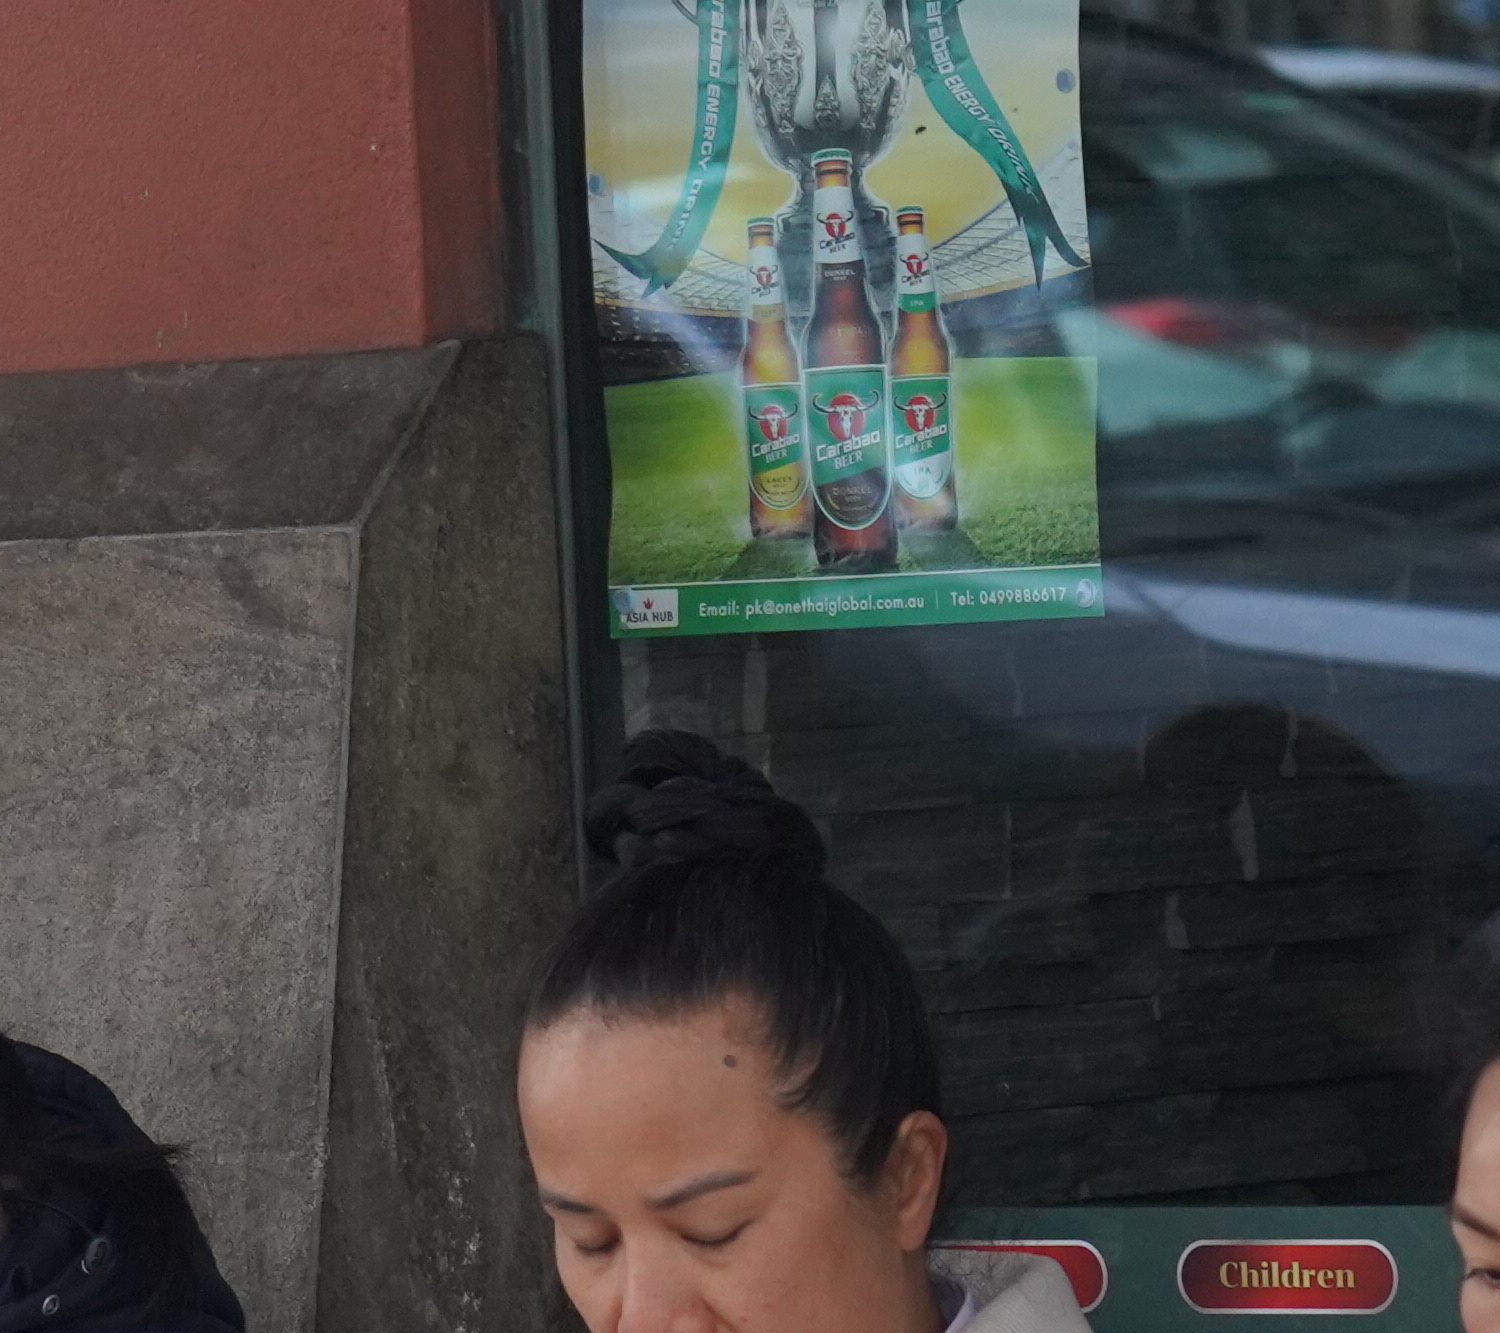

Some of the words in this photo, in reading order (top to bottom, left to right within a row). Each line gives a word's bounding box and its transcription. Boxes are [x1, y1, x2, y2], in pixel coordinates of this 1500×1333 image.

[944, 75, 995, 124] ENERGY
[698, 83, 720, 170] ENERGY
[752, 433, 800, 458] Carabao
[816, 430, 881, 461] Carabao
[895, 423, 948, 448] Carabao
[834, 450, 863, 470] BEER
[626, 611, 649, 623] ASIA
[652, 610, 674, 623] HUB
[699, 600, 740, 618] Email:
[745, 595, 924, 620] pk@onethaiglobal.com.au
[950, 590, 975, 607] Tel:
[979, 587, 1066, 605] 0499886617
[1219, 1260, 1355, 1288] Children
